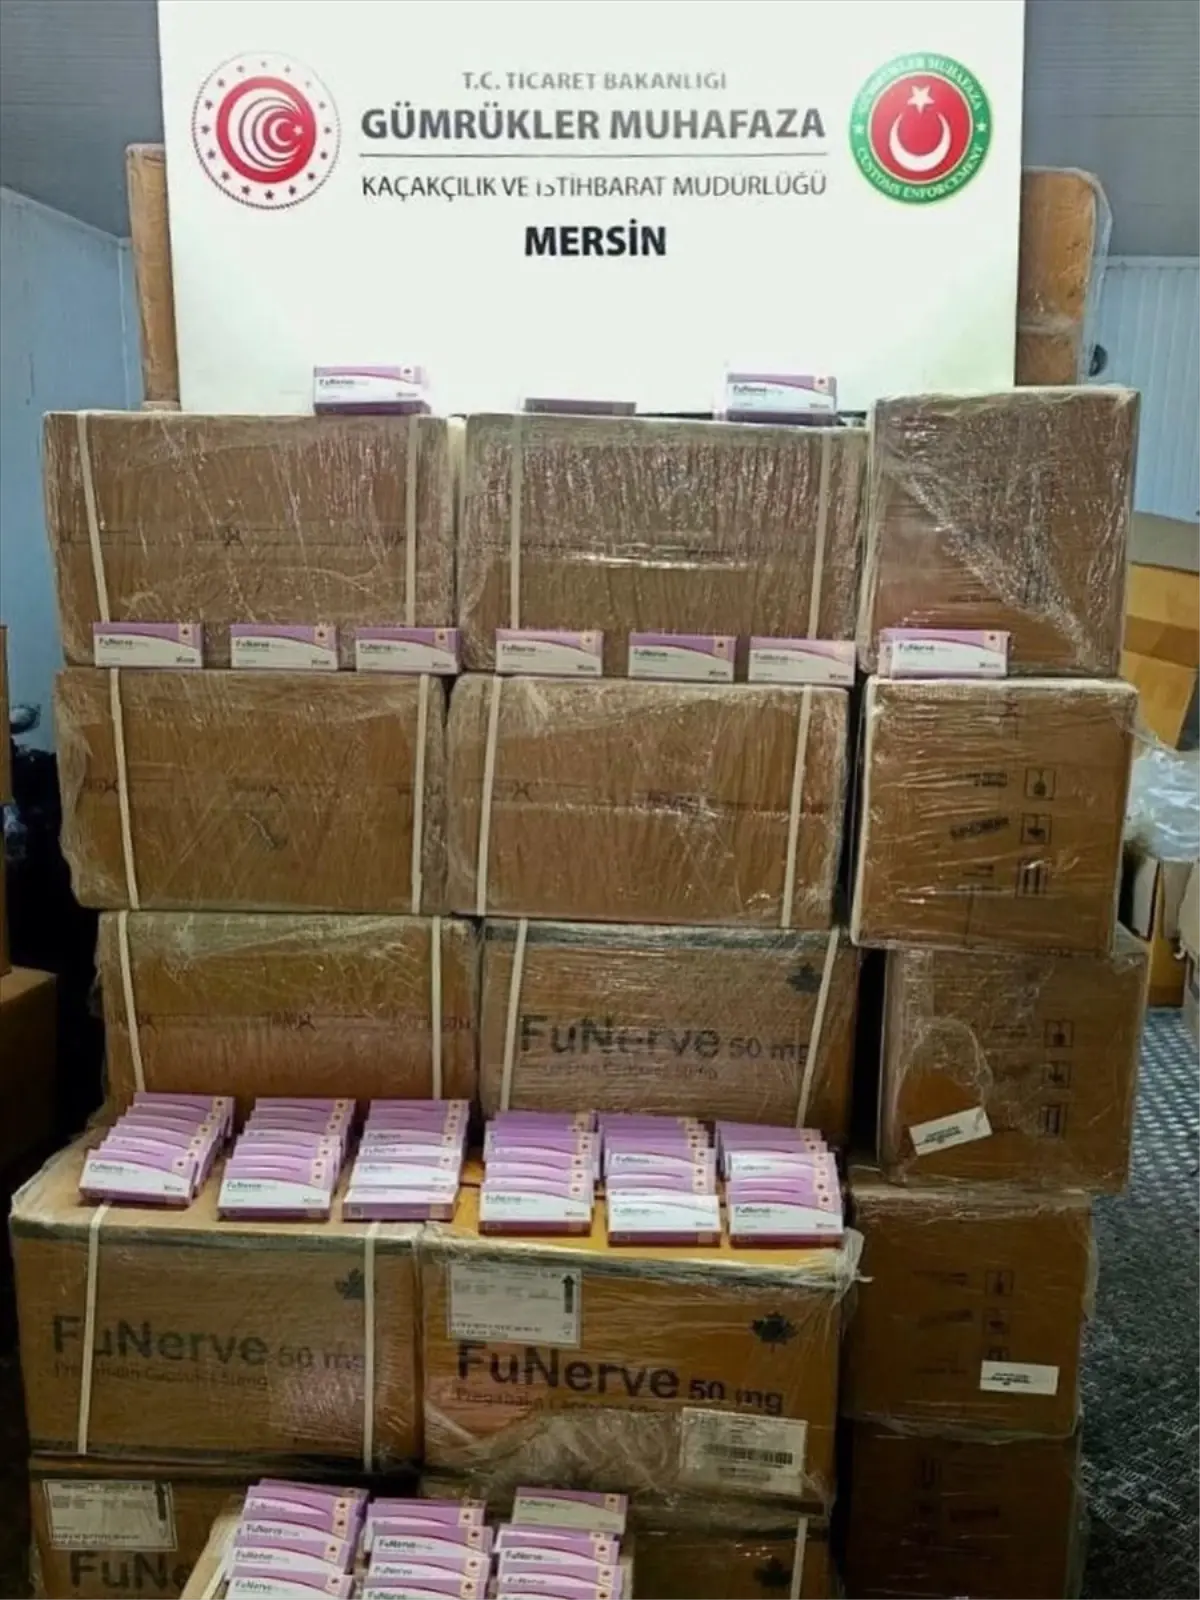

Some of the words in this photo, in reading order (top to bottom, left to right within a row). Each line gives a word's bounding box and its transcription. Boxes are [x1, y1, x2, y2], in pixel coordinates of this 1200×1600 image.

[462, 71, 501, 90] T.C.
[361, 101, 600, 140] GÜMRÜKLER
[610, 108, 825, 139] MUHAFAZA
[362, 175, 496, 202] KAÇAKÇILIK
[502, 175, 529, 197] VE
[524, 218, 666, 257] MERSİN
[519, 1013, 721, 1059] FuNerve
[729, 1036, 762, 1059] 50
[53, 1315, 269, 1366] FuNerve
[456, 1339, 680, 1399] FuNerve
[688, 1379, 725, 1402] 50
[736, 1388, 784, 1416] mg
